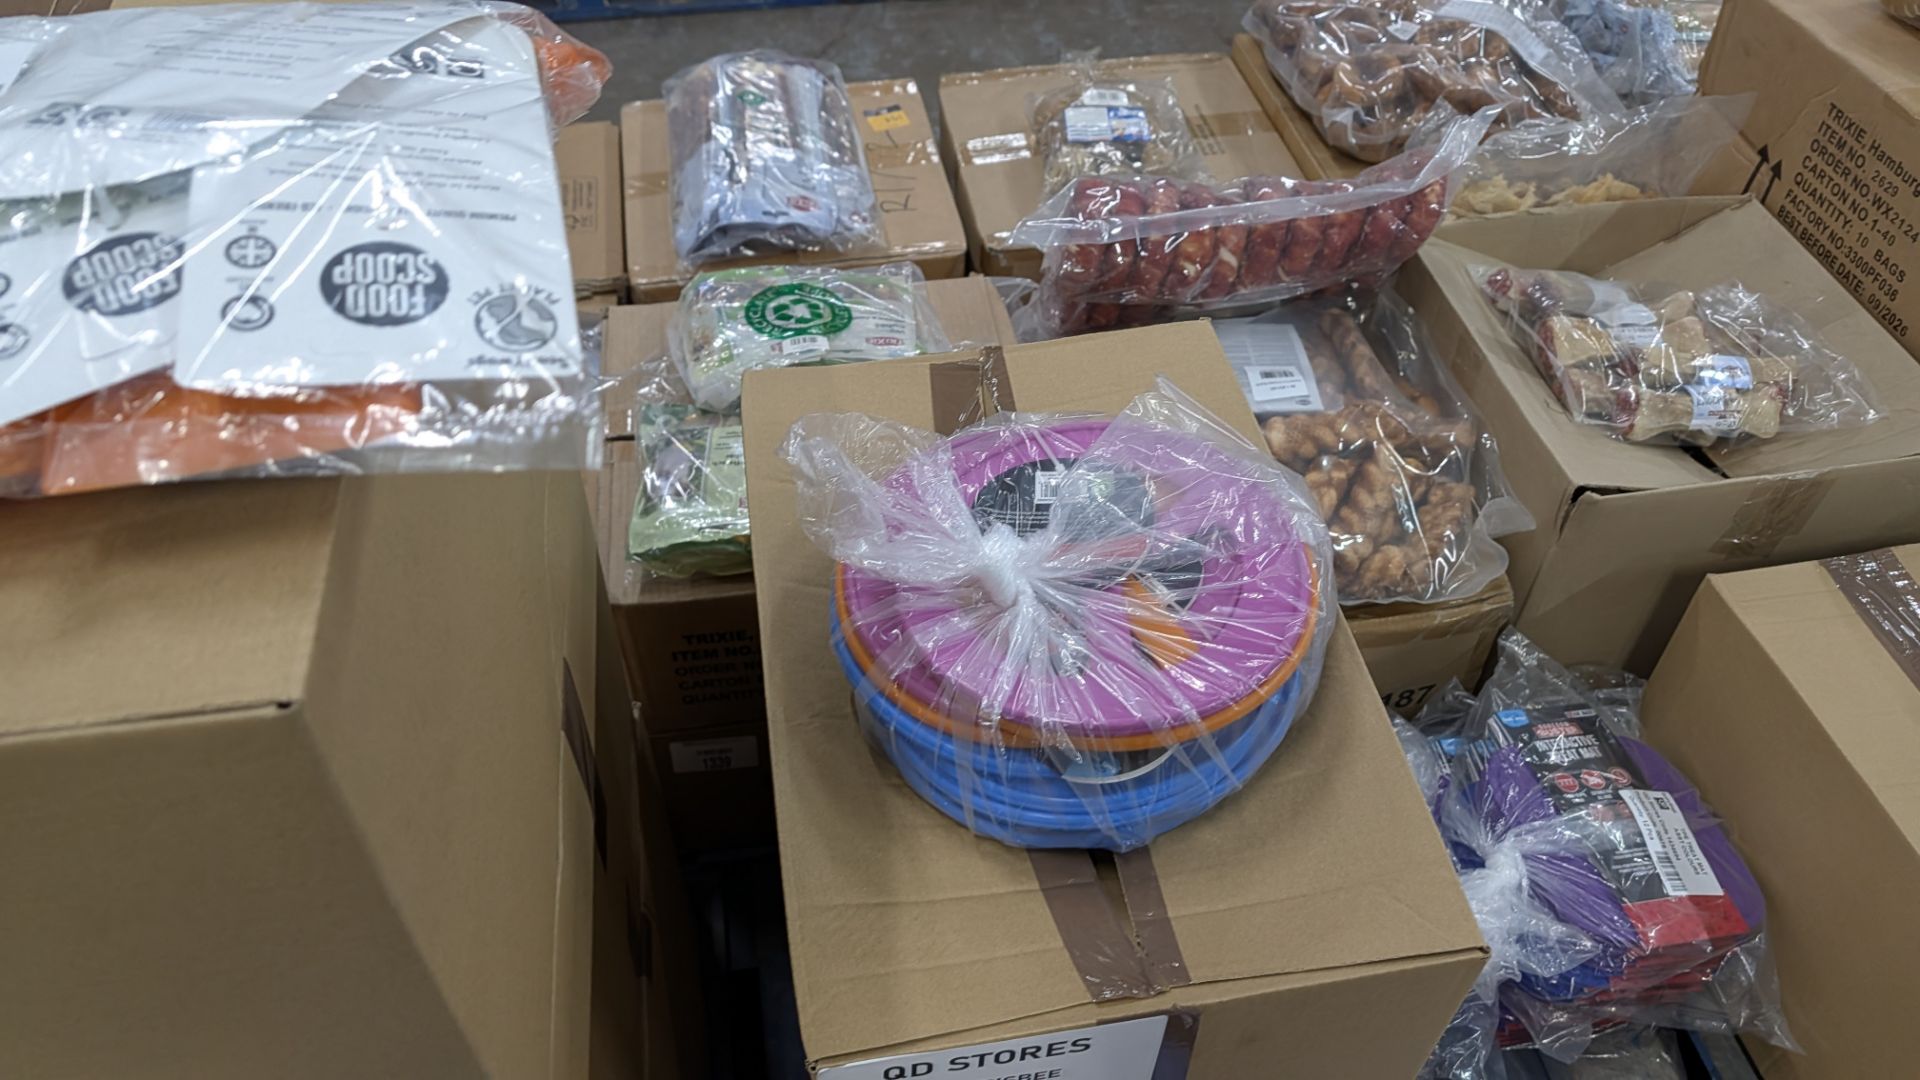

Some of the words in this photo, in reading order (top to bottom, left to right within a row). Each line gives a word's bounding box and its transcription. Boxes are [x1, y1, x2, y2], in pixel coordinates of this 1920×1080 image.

[1827, 102, 1867, 149] TRIXIE,
[1802, 155, 1850, 205] CARTON
[1810, 138, 1851, 181] ORDER
[1818, 120, 1847, 153] ITEM
[1846, 146, 1867, 173] NO.
[1871, 169, 1900, 197] 2629
[1785, 188, 1830, 235] FACTORY
[1794, 172, 1853, 235] QUANTITY:
[1856, 232, 1870, 248] 10
[1874, 249, 1907, 283] BAGS
[331, 252, 437, 284] SCOOP
[1777, 204, 1802, 233] BEST
[1800, 228, 1838, 270] BEFORE
[1835, 262, 1867, 296] DATE:
[1867, 293, 1910, 337] 09/2026
[344, 282, 427, 317] FOOD
[672, 648, 720, 661] ITEM
[883, 1061, 934, 1080] QD
[948, 1037, 1093, 1072] STORES
